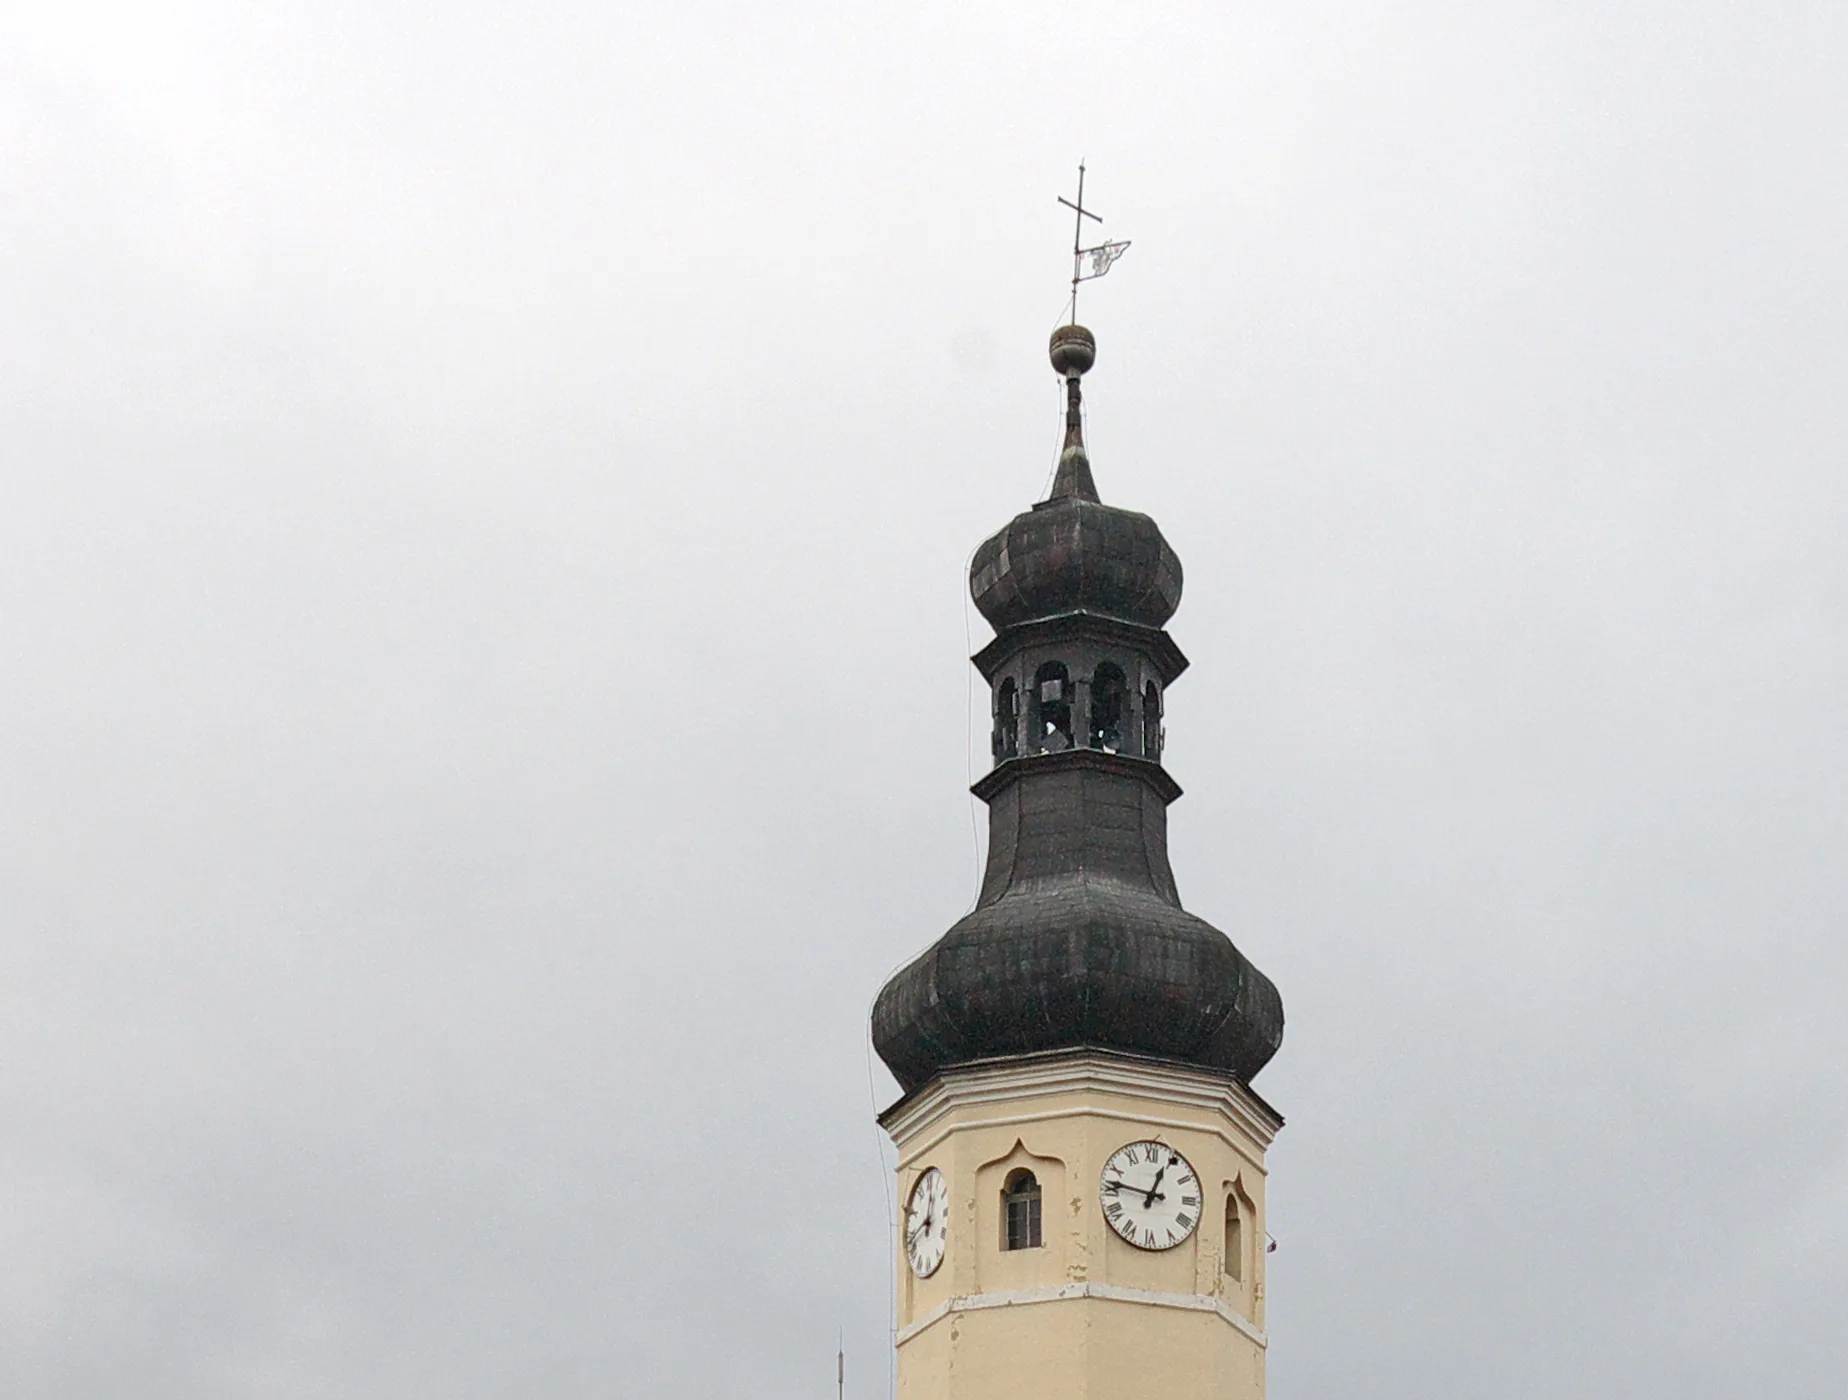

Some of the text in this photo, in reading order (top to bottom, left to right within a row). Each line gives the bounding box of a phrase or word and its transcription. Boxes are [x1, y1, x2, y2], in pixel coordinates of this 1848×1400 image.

[1123, 1148, 1140, 1167] XI
[1109, 1164, 1125, 1178] X
[1145, 1228, 1157, 1248] VI
